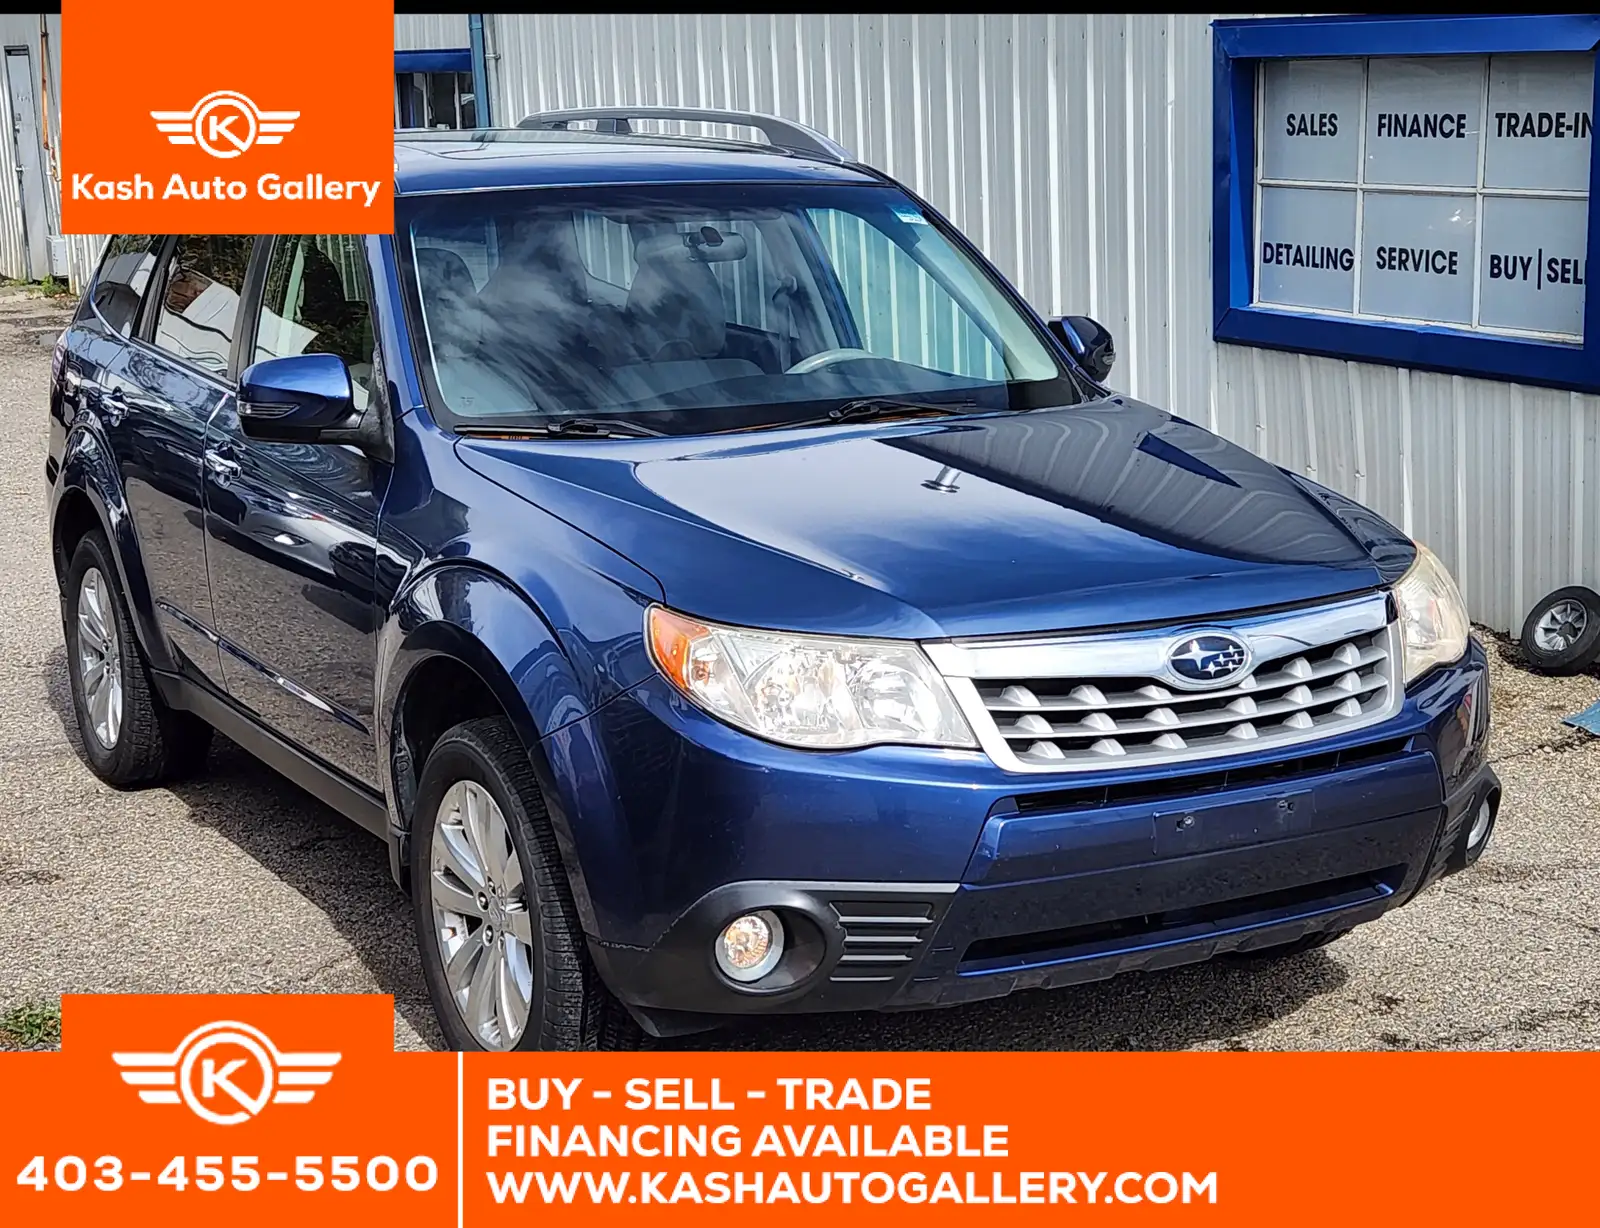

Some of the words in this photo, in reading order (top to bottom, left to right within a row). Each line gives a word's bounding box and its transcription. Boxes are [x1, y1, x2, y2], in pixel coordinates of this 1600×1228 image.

[1285, 113, 1338, 137] SALES
[1377, 113, 1467, 138] FINANCE
[1495, 112, 1593, 138] TRADE-IN
[1262, 242, 1355, 272] DETAILING
[1376, 246, 1458, 275] SERVICE
